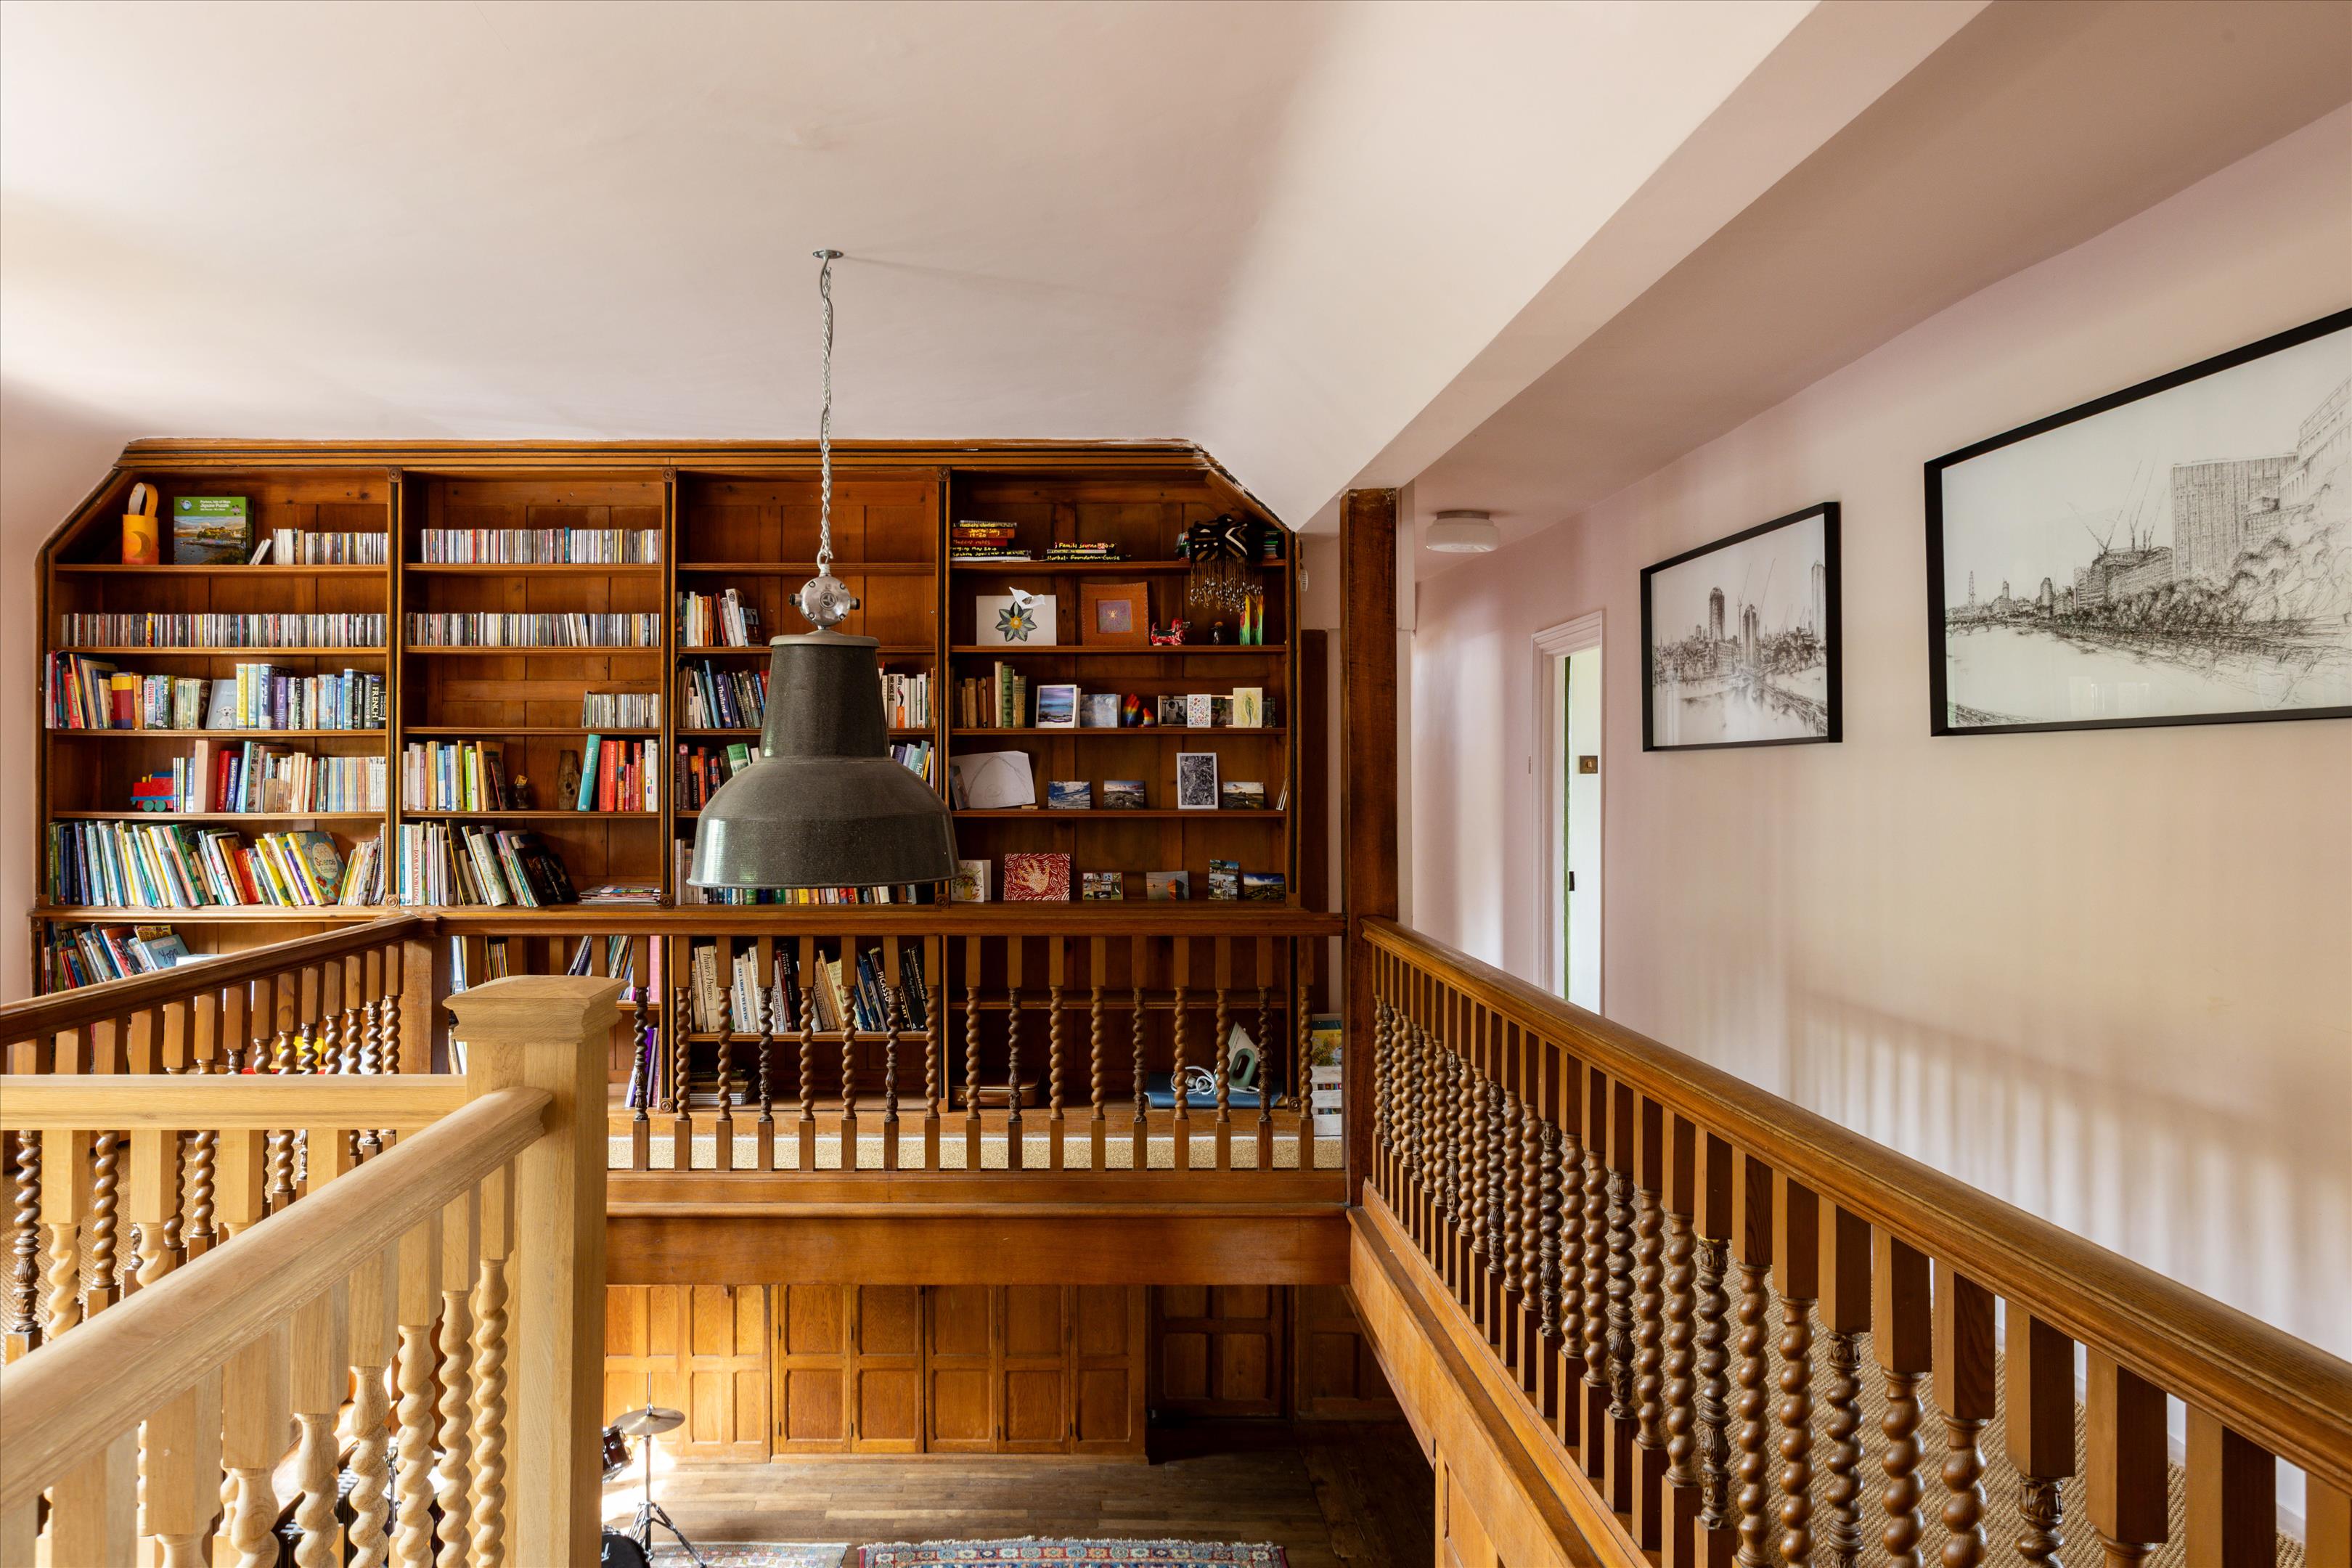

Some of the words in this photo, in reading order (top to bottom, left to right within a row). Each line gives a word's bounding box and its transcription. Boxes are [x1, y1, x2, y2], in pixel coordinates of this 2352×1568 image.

[717, 685, 728, 713] Thailand
[585, 748, 594, 773] Vegetarian
[315, 857, 336, 866] Science
[159, 948, 180, 964] Yoga
[705, 978, 714, 1001] Progress
[814, 983, 824, 1011] PATTERNS
[877, 971, 890, 1003] PICASSO
